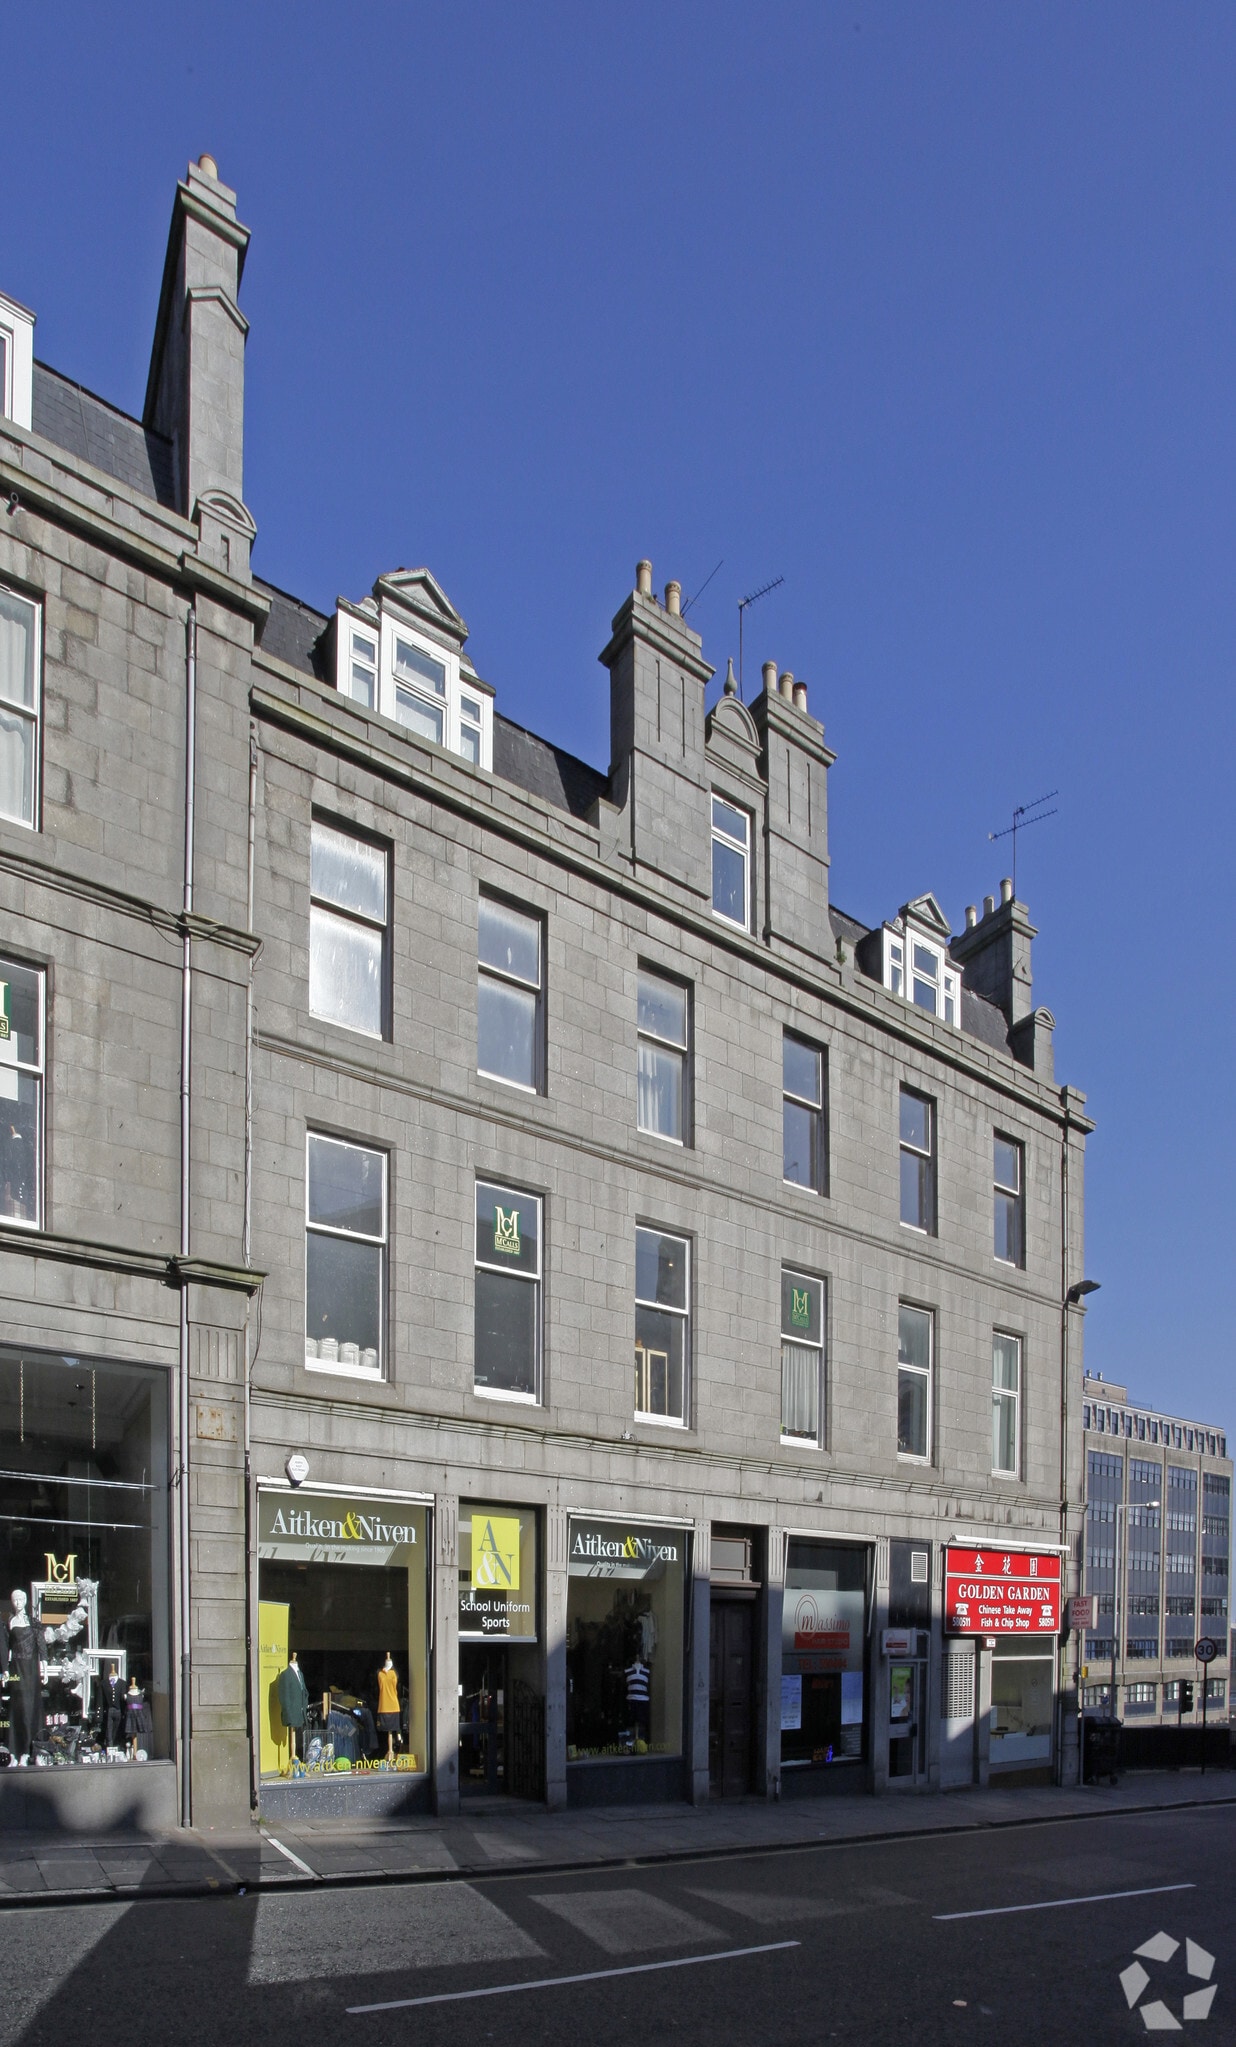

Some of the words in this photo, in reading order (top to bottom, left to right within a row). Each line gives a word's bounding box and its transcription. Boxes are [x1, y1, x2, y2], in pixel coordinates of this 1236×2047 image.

[269, 1508, 418, 1544] Aitken&Niven
[571, 1533, 678, 1562] Aitken&Niven
[958, 1584, 1005, 1600] GOLDEN
[1007, 1586, 1050, 1601] GARDEN
[460, 1600, 491, 1612] School
[493, 1600, 530, 1613] Uniform
[1073, 1600, 1088, 1608] FAST
[978, 1605, 1001, 1615] Chinese
[1002, 1605, 1016, 1615] Take
[1016, 1606, 1033, 1616] Away
[1071, 1608, 1090, 1617] FOOD
[481, 1616, 511, 1630] Sports
[980, 1618, 993, 1627] Fish
[994, 1618, 999, 1627] &
[1001, 1618, 1014, 1629] Chip
[1015, 1618, 1030, 1628] Shop
[1197, 1645, 1213, 1656] 30
